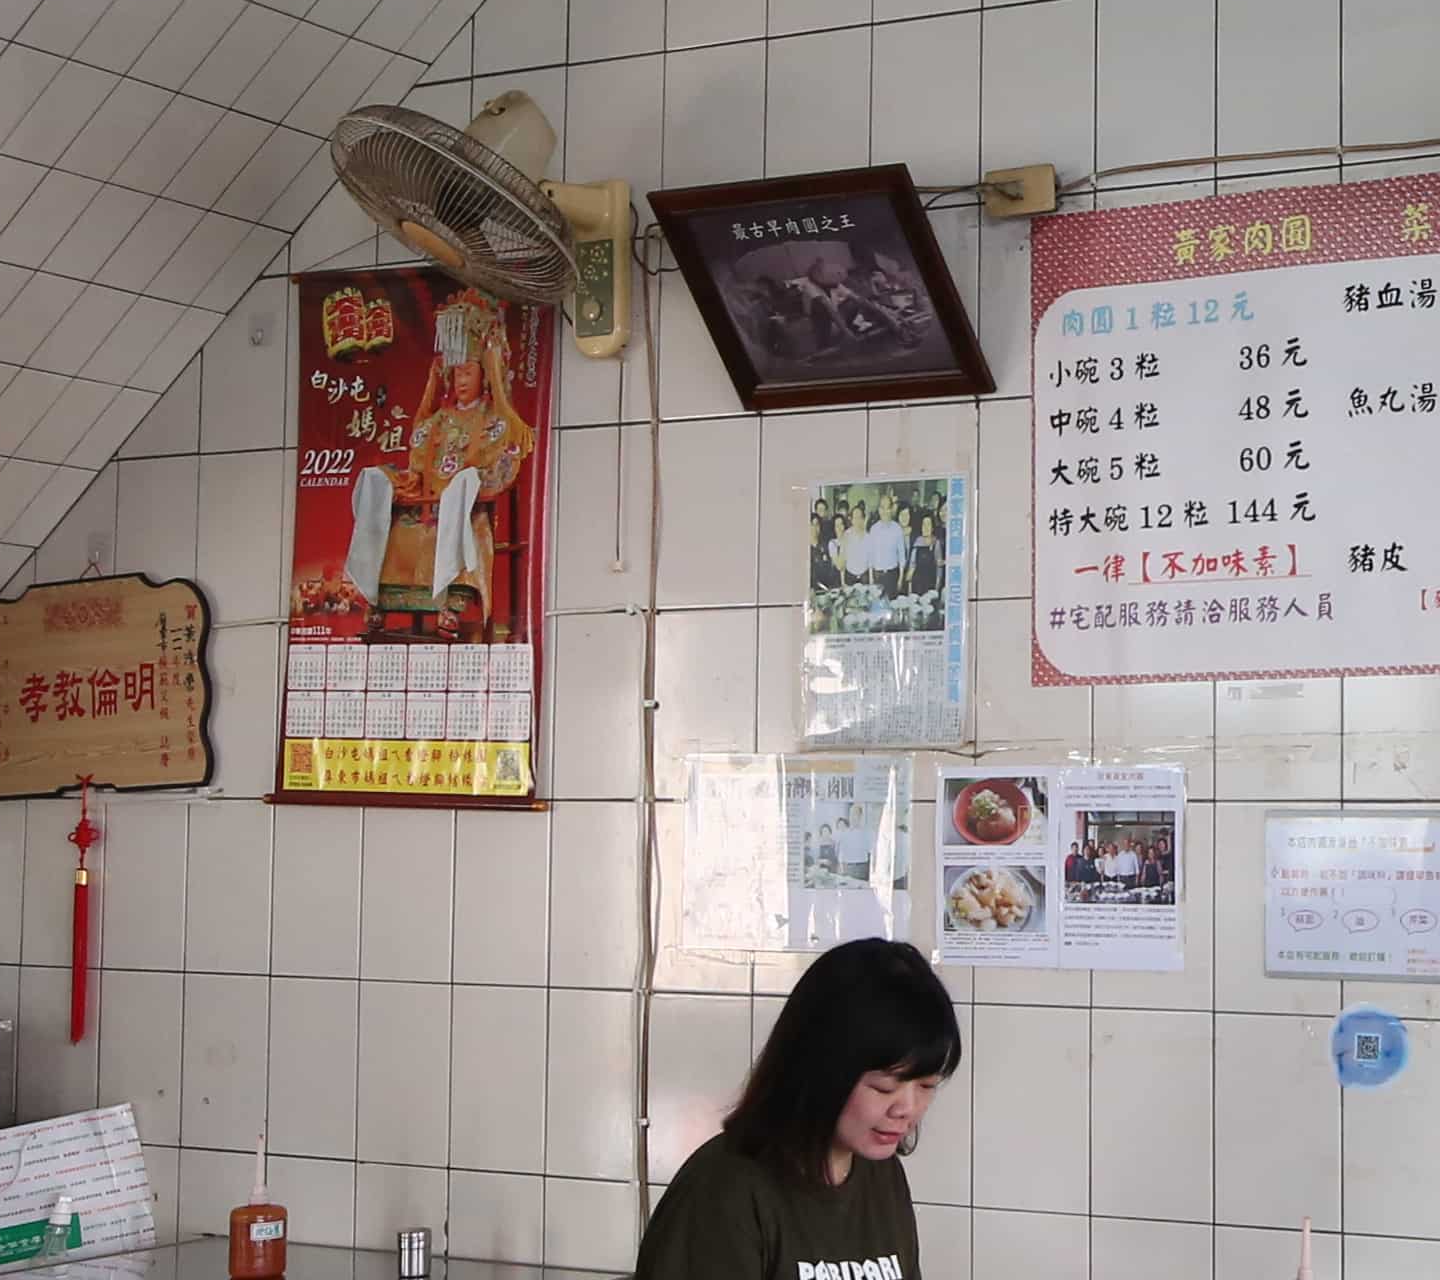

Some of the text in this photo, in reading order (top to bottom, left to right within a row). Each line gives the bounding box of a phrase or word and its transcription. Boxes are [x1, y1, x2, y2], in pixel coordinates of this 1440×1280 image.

[1172, 215, 1313, 266] 黃家肉圓
[1343, 279, 1439, 314] 豬血湯
[311, 370, 370, 404] 白沙屯
[1348, 383, 1439, 416] 魚丸湯
[301, 449, 355, 475] 2022
[300, 477, 350, 487] CALENDAR
[1348, 542, 1409, 573] 豬皮
[1049, 593, 1335, 631] #宅配服務請洽服務人員
